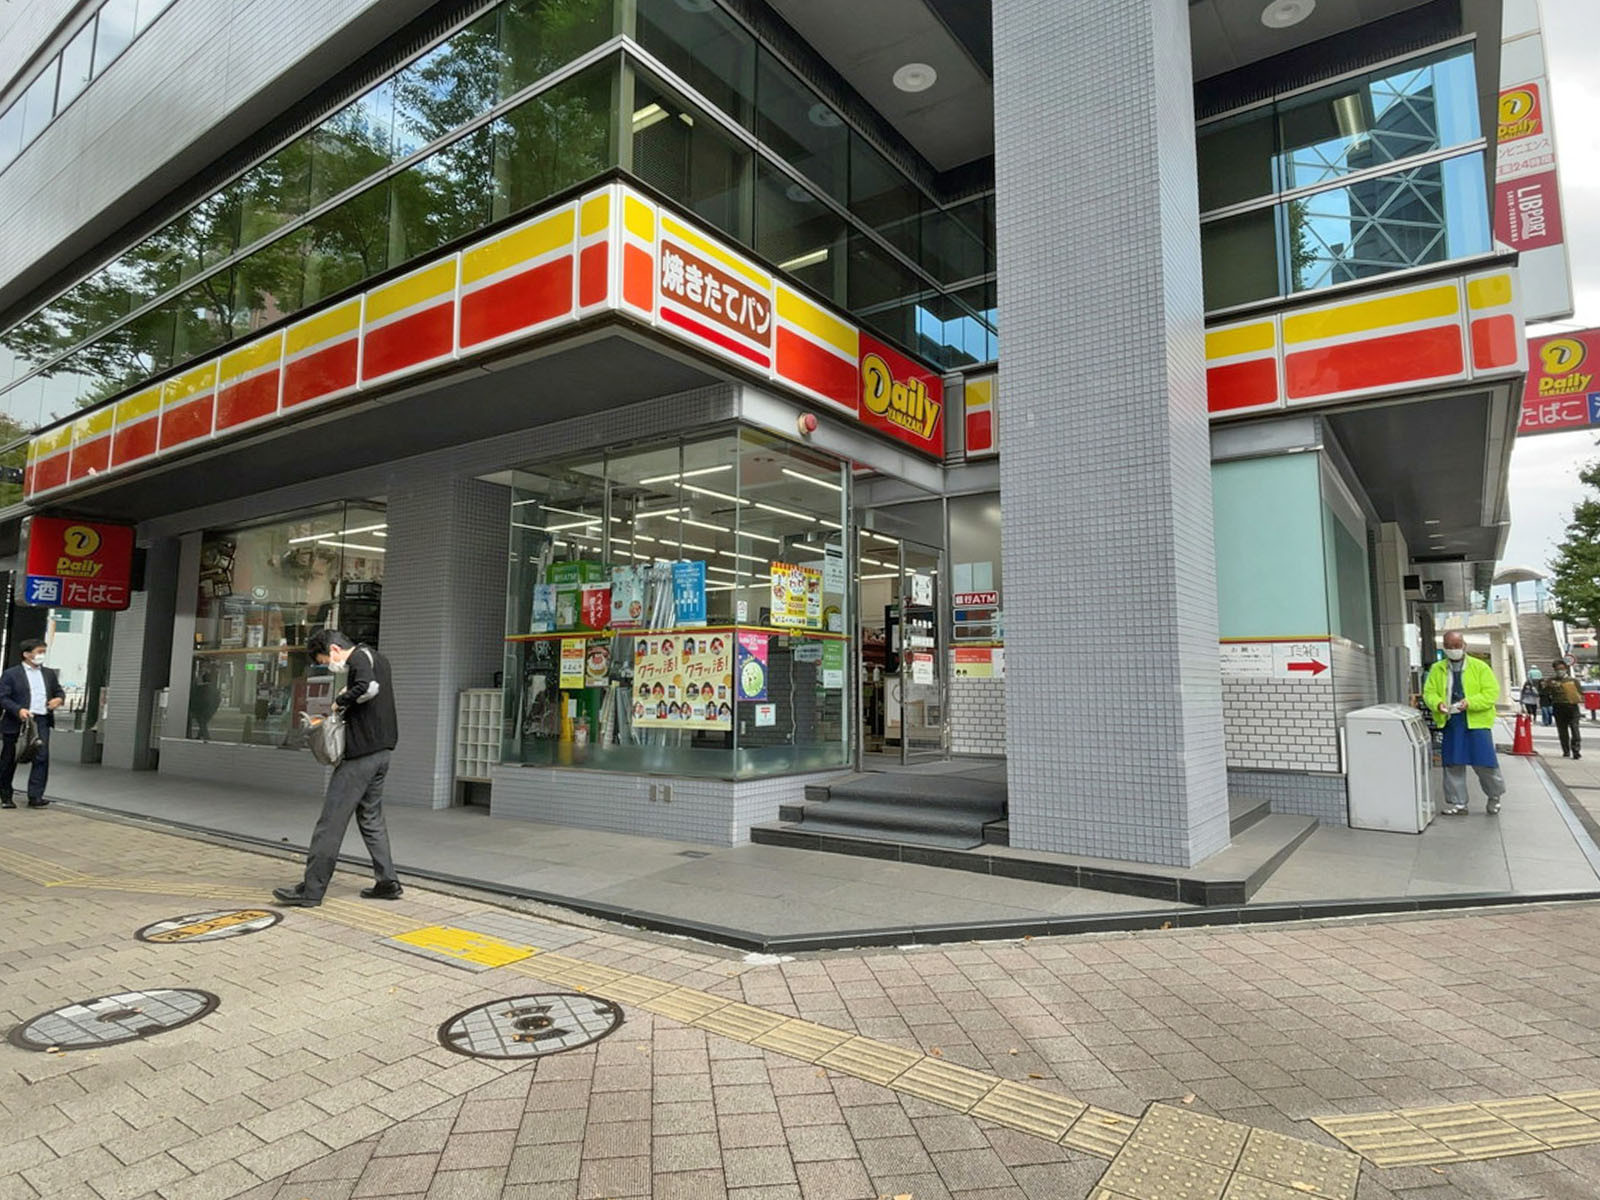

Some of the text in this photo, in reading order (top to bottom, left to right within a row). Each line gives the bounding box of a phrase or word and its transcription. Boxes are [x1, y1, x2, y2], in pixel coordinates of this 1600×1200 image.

[1517, 184, 1547, 238] LIBPORT
[662, 249, 770, 334] 焼きたてパン
[862, 353, 941, 439] Daily
[1539, 373, 1593, 393] Daily
[57, 557, 103, 577] Daily
[31, 579, 124, 604] 酒 たばこ
